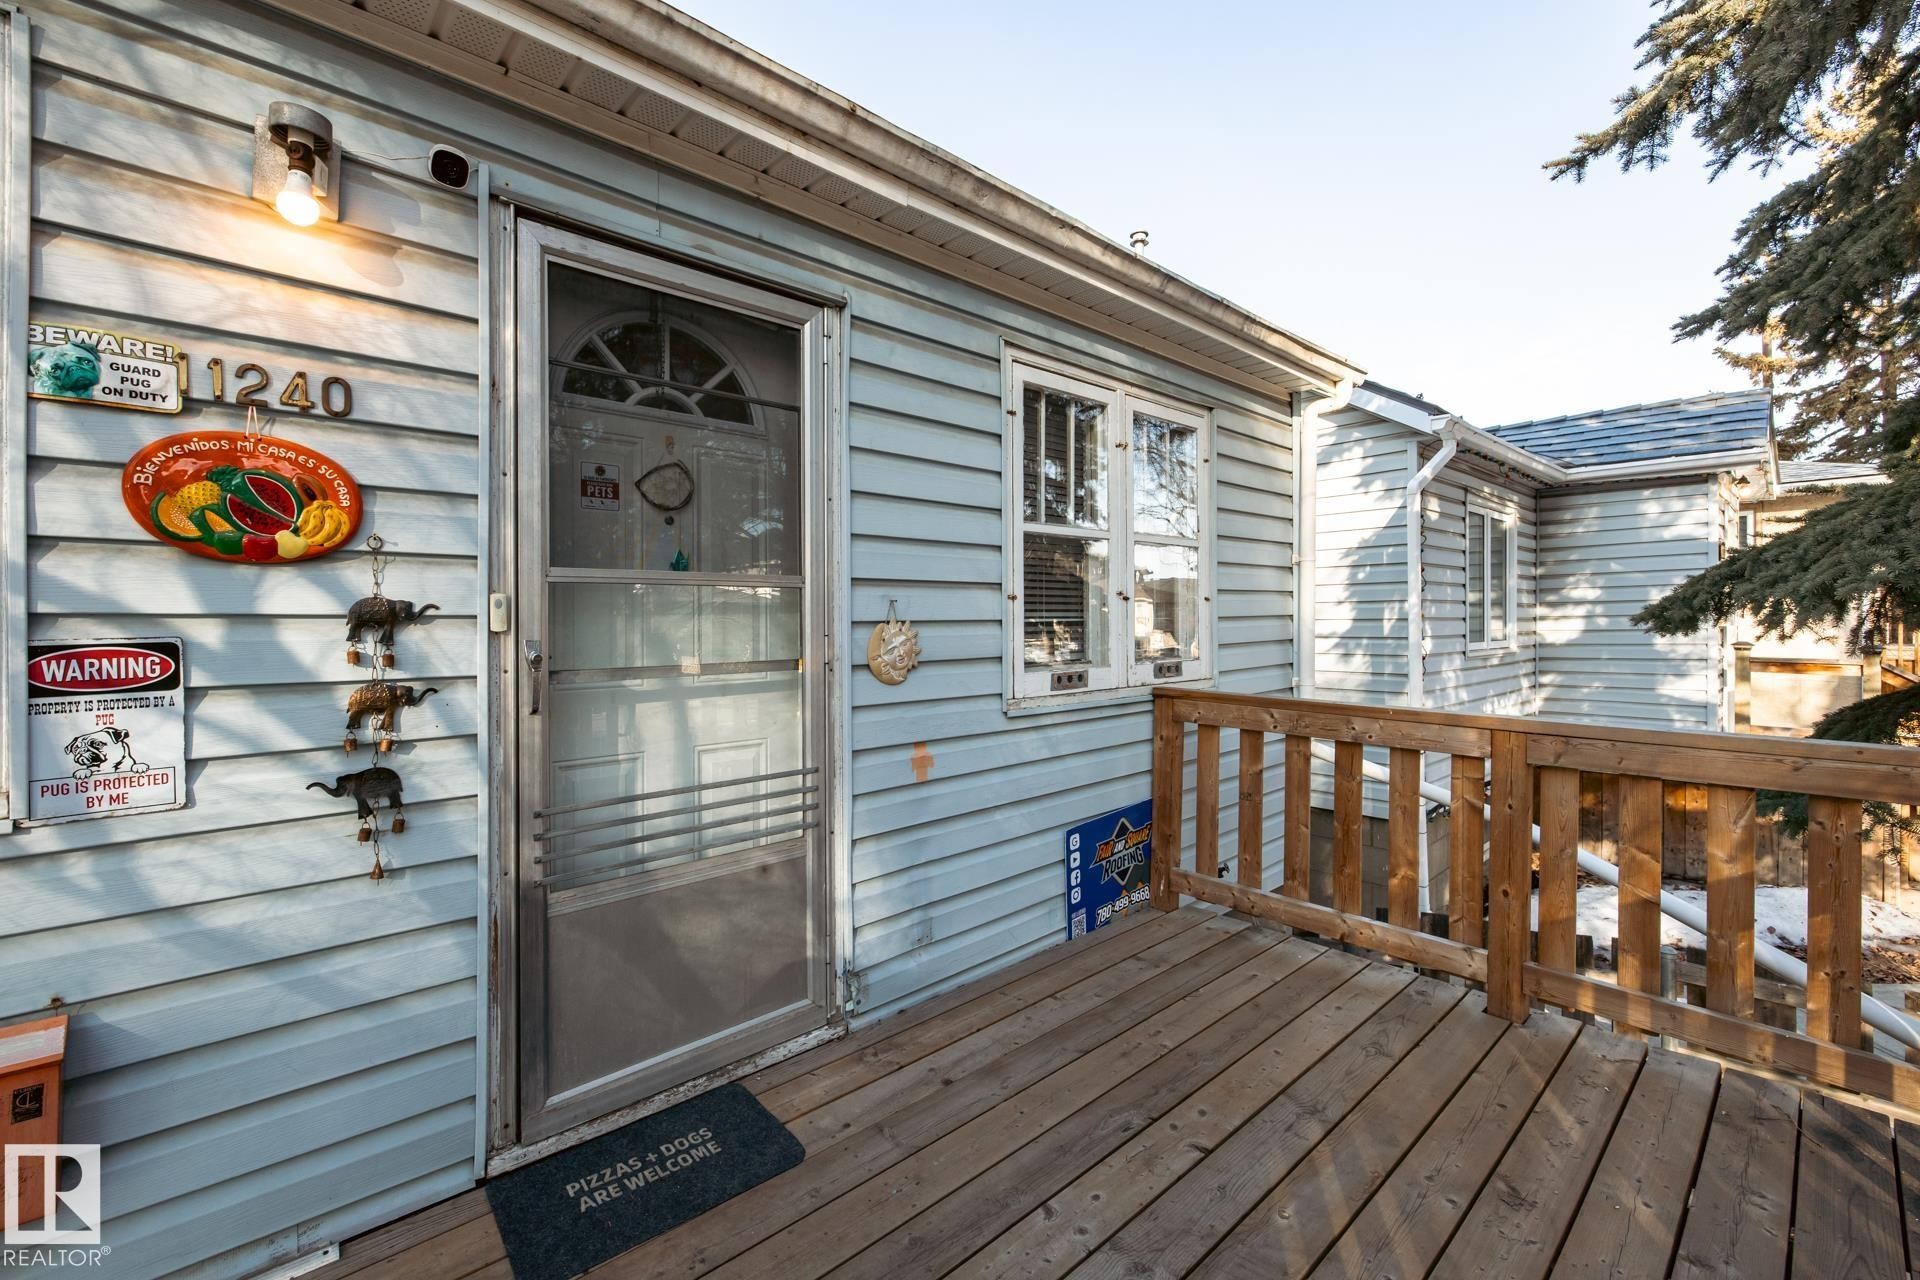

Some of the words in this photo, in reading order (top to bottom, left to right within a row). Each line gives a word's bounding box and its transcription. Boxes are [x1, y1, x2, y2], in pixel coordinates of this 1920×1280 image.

[28, 324, 174, 363] BEWARE!
[109, 362, 161, 378] GUARD
[120, 376, 151, 388] PUG
[102, 386, 124, 397] ON
[129, 390, 168, 403] DUTY
[258, 443, 296, 461] CASA
[298, 456, 316, 468] ES
[318, 465, 338, 479] SU
[334, 479, 351, 507] CASA
[587, 486, 614, 498] PETS
[40, 656, 160, 682] WARNING
[28, 700, 81, 716] PROPERTY
[84, 700, 94, 712] IS
[96, 697, 150, 711] PROTECTED
[153, 698, 166, 708] BY
[168, 696, 176, 706] A
[96, 714, 114, 726] PUG
[40, 783, 70, 798] PUG
[75, 780, 89, 794] IS
[93, 772, 169, 791] PROTECTED
[86, 796, 104, 809] BY
[109, 792, 129, 806] ME
[1103, 846, 1144, 880] ROOFING
[566, 1157, 642, 1198] PIZZAS
[659, 1128, 712, 1156] DOGS
[579, 1184, 623, 1213] ARE
[623, 1141, 722, 1191] WELCOME
